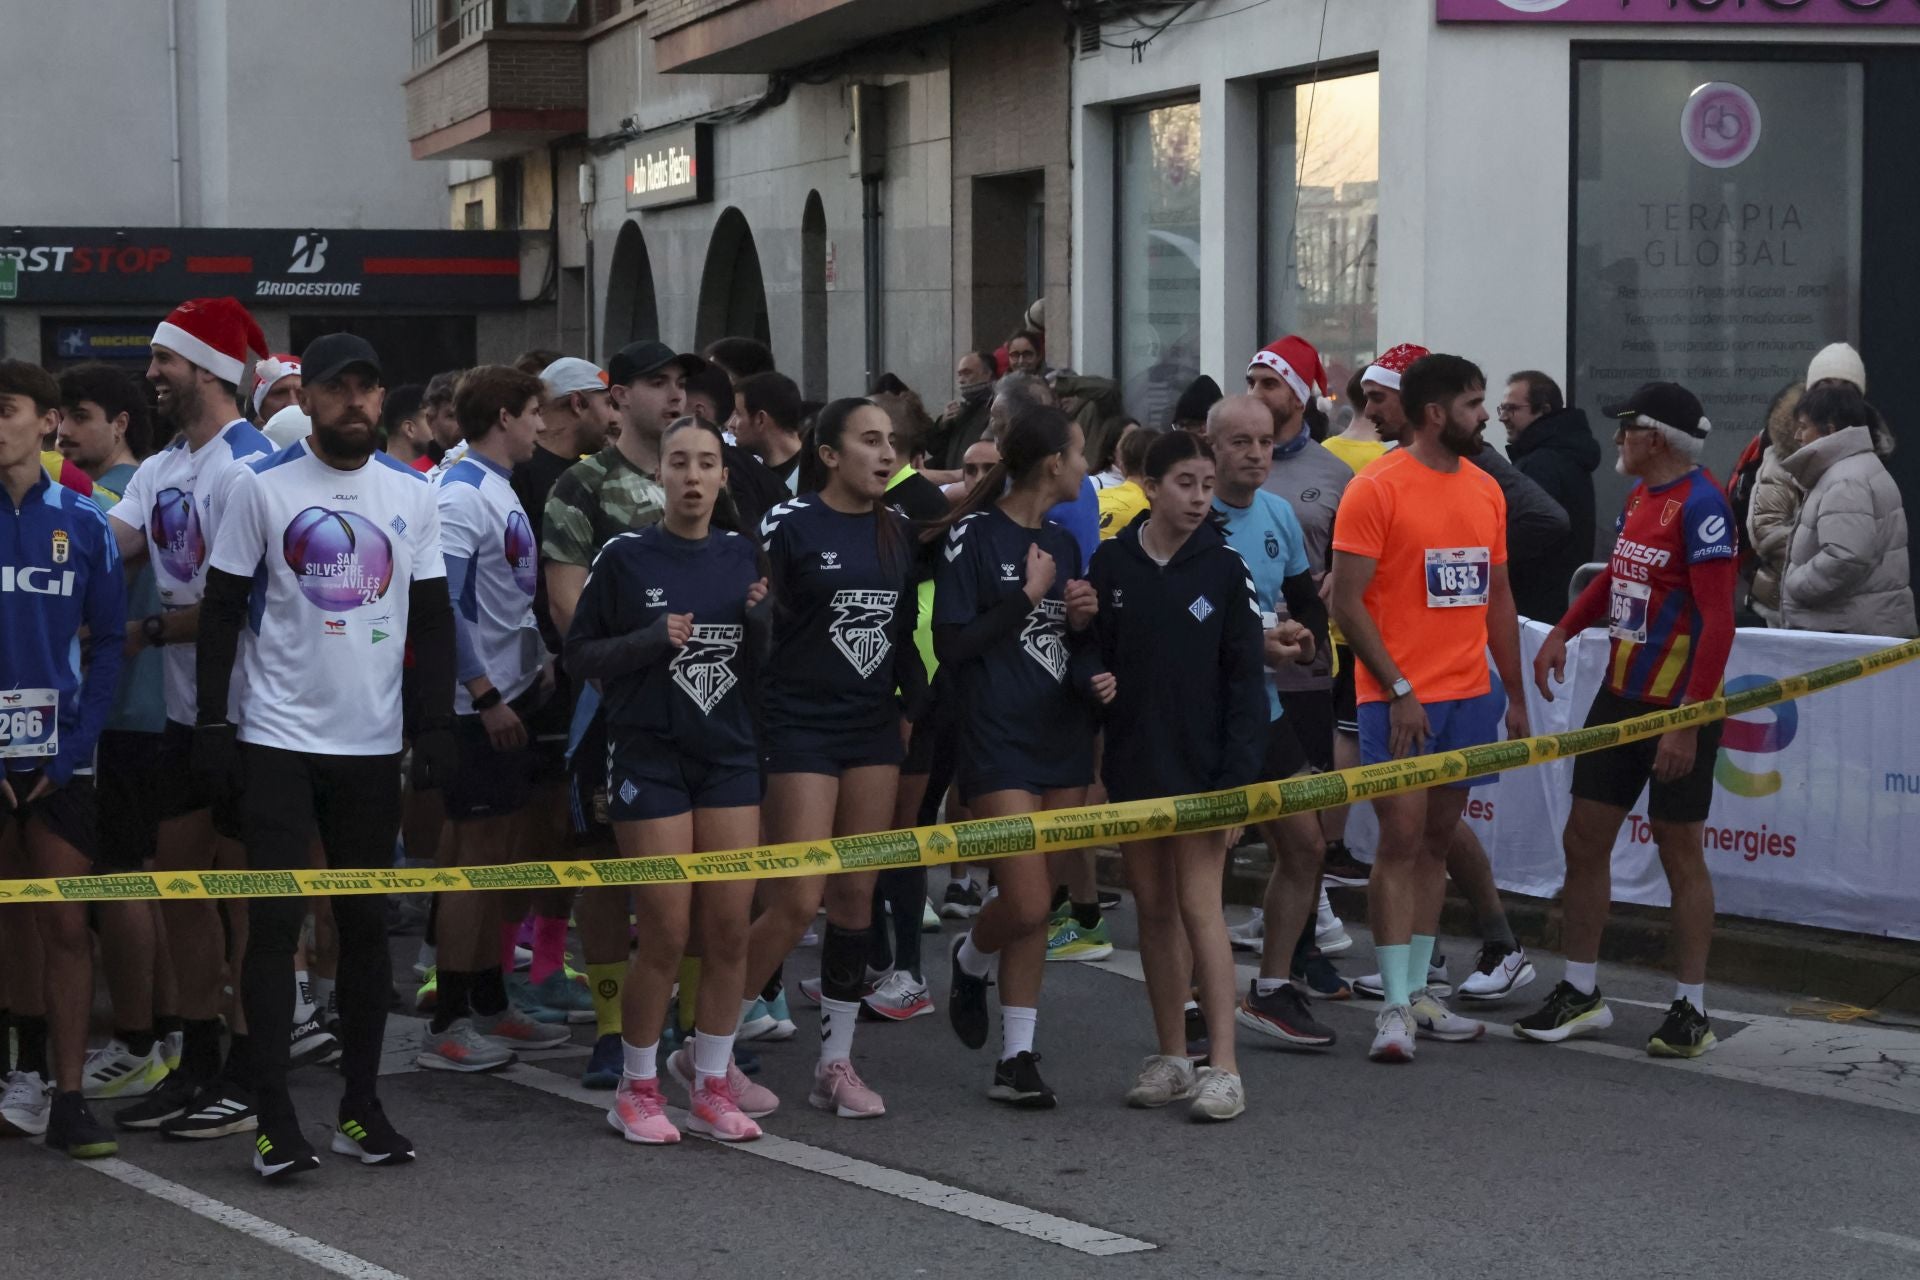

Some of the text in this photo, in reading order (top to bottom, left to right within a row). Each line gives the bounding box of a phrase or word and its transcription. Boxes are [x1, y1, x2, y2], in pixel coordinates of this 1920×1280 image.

[647, 153, 668, 191] Ruedas
[1639, 203, 1802, 231] TERAPIA
[1645, 239, 1798, 267] GLOBAL
[256, 281, 362, 296] BRIDGESTONE
[336, 552, 359, 565] SAN
[305, 563, 366, 577] SILVESTRE
[342, 574, 380, 589] AVILÉS
[1437, 565, 1480, 591] 1833
[832, 592, 897, 605] ATLETICA
[1352, 770, 1437, 798] CAJA RURAL
[967, 818, 1030, 833] RECICLADO
[1054, 813, 1102, 825] ASTURIAS
[1040, 822, 1140, 844] CAJA RURAL
[847, 834, 912, 849] AMBIENTE
[959, 837, 1034, 858] FABRICADO
[700, 851, 772, 864] DE ASTURIAS
[838, 842, 917, 859] CON EL MEDIO
[687, 858, 800, 876] CAJA RURAL
[72, 878, 150, 888] AMBIENTE
[304, 879, 426, 891] CAJA RURAL
[601, 872, 684, 883] FABRICADO
[61, 887, 105, 897] MEDIO
[106, 887, 122, 895] EL
[125, 885, 155, 895] CON
[208, 886, 299, 896] FABRICADO
[290, 1021, 320, 1041] HOKA
